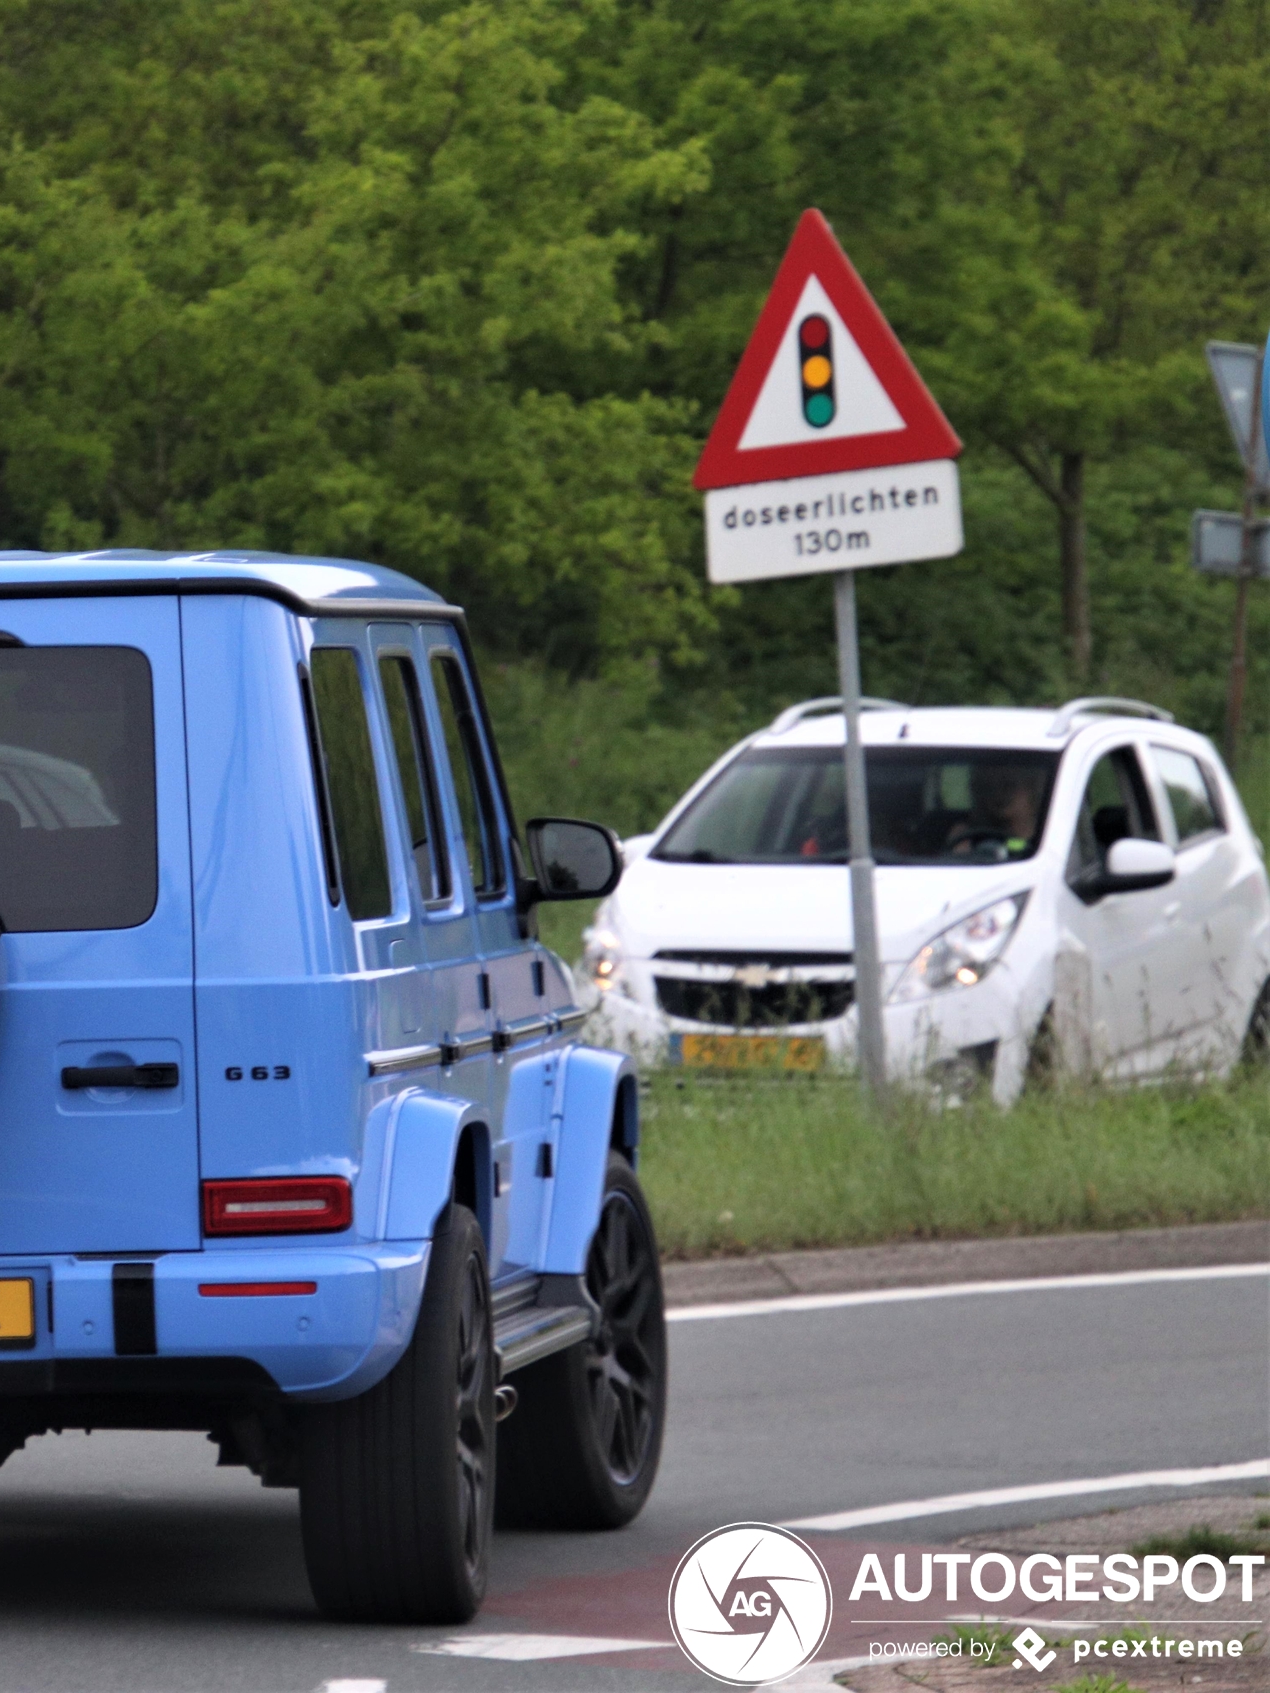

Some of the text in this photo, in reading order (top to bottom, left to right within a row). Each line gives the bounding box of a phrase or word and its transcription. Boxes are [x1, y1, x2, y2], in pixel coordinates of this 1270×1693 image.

[724, 486, 939, 529] doseerlichten
[794, 528, 871, 556] 130m
[225, 1066, 290, 1080] G 63
